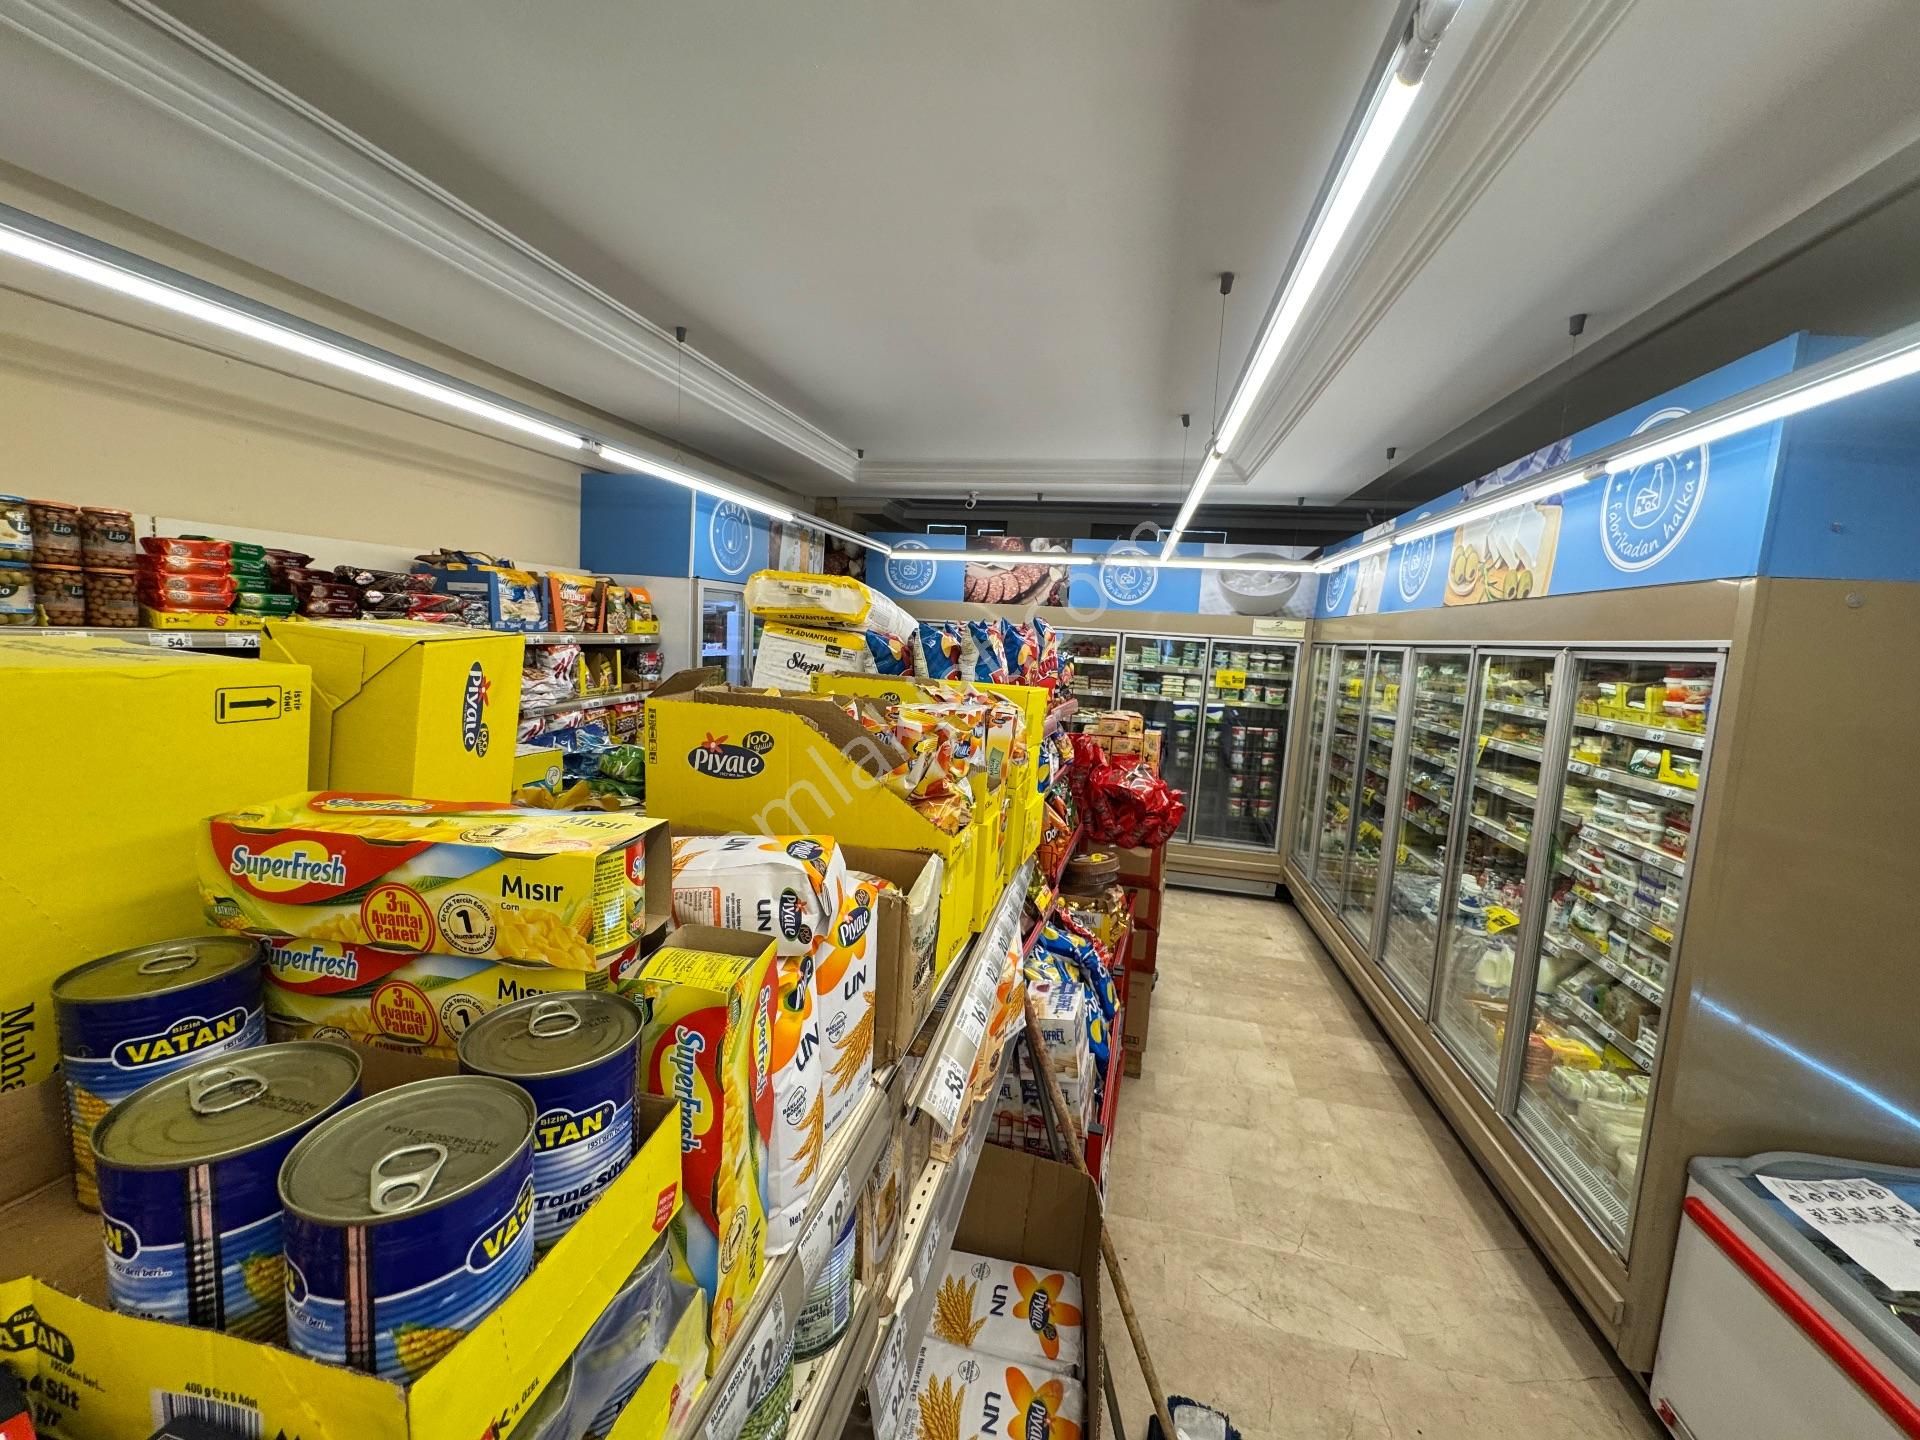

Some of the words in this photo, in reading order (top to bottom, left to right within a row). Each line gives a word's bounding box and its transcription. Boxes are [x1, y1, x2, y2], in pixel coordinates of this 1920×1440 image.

[53, 524, 71, 534] Lio
[1609, 502, 1660, 558] fabrikadan
[1664, 480, 1695, 539] halka
[109, 531, 126, 541] Lio
[168, 638, 184, 647] 54
[242, 638, 256, 647] 74
[796, 630, 839, 644] ADVANTAGE
[465, 671, 482, 745] Piyale
[747, 734, 770, 748] 100
[694, 748, 760, 774] Piyale
[232, 847, 346, 886] SuperFresh
[501, 874, 564, 902] Mısır
[371, 910, 424, 931] Avantaj
[452, 897, 473, 905] Tercih
[473, 901, 491, 922] Edilen
[456, 909, 473, 934] 1
[500, 902, 520, 911] Corn
[757, 899, 772, 932] UN
[782, 894, 797, 937] Piyale
[375, 925, 420, 943] Paketi
[840, 909, 869, 948] Piyale
[497, 978, 548, 1000] Mıs
[844, 965, 867, 1001] UN
[380, 1003, 427, 1026] Avantaj
[385, 1018, 425, 1036] Paketi
[125, 1015, 237, 1063] VATAN
[755, 984, 773, 1102] SuperFresh
[795, 1022, 820, 1072] UN
[671, 1025, 705, 1154] SuperFresh
[945, 1069, 964, 1100] 53
[534, 1110, 603, 1150] TAN
[540, 1114, 568, 1126] BİZİM
[535, 1185, 593, 1210] Tane
[483, 1200, 534, 1260] VAT
[789, 1212, 801, 1228] Net
[990, 1284, 1009, 1317] UN
[1031, 1291, 1048, 1329] Piyale
[0, 1321, 65, 1358] ATAN
[185, 1382, 202, 1395] 400
[747, 1338, 774, 1409] 69
[710, 1404, 728, 1426] SUPER
[728, 1368, 743, 1395] FRESH
[981, 1391, 1002, 1436] UN
[1029, 1403, 1047, 1440] Piya
